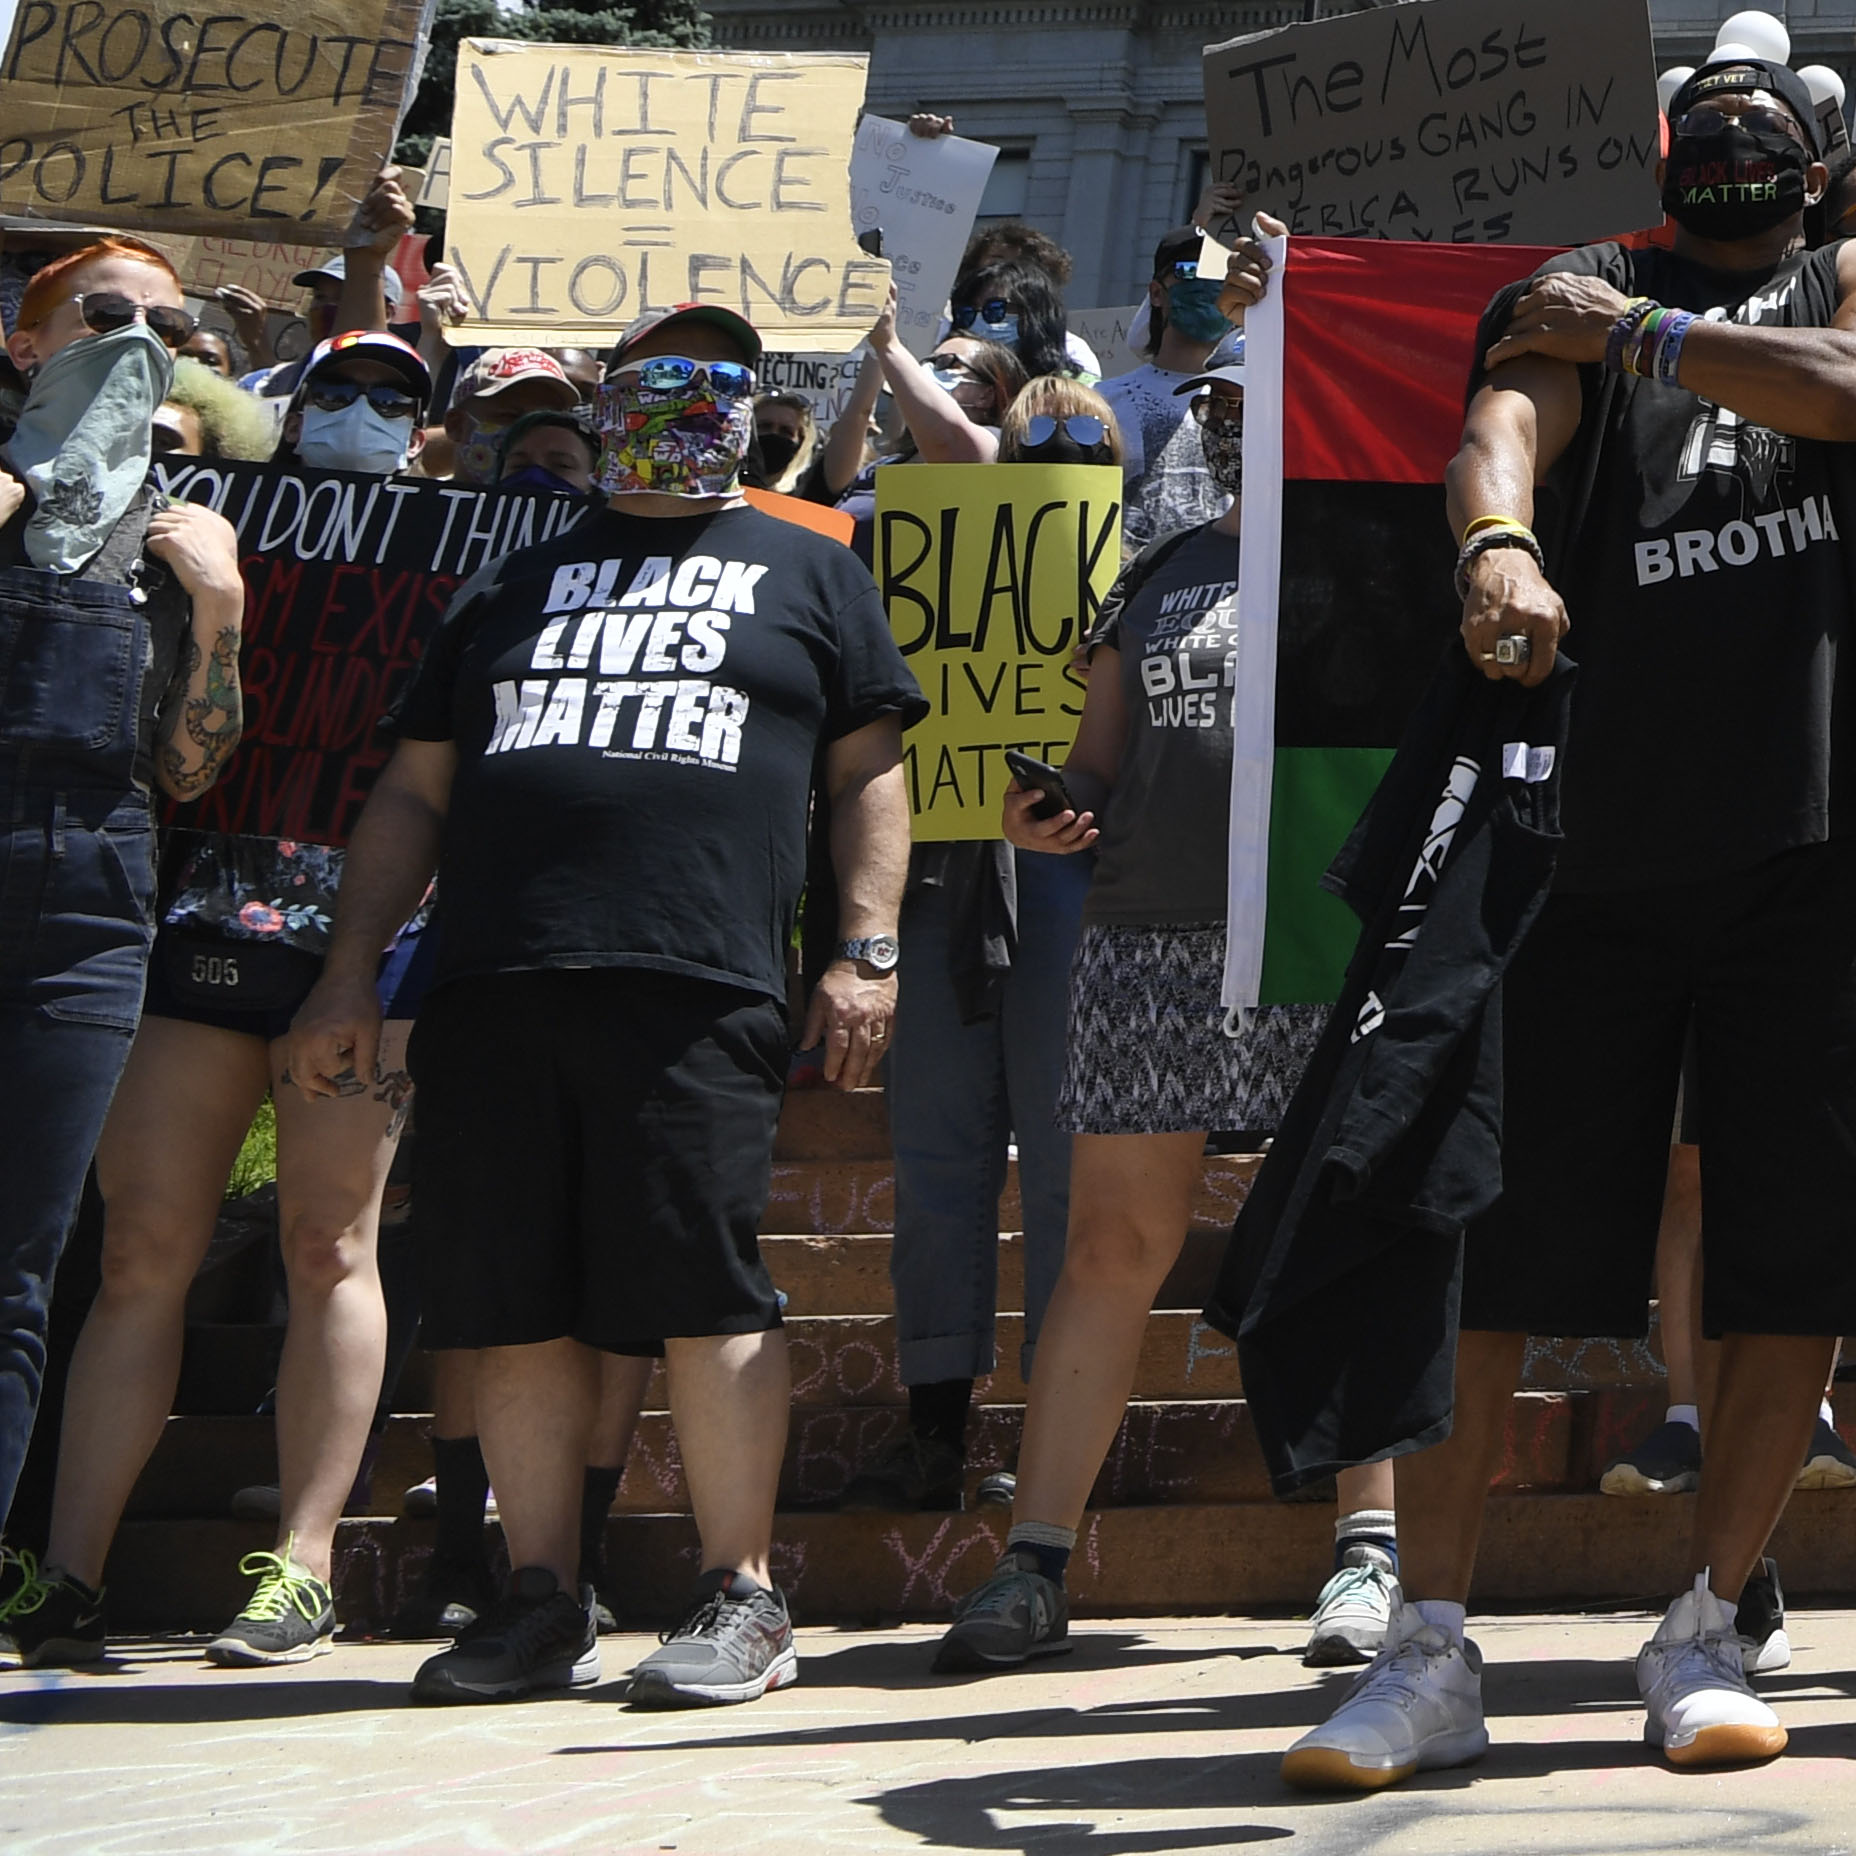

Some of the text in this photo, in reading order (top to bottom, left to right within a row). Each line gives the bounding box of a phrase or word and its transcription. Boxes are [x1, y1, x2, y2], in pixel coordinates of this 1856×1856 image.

[7, 1, 415, 106] PROSECUTE
[1229, 16, 1547, 136] The Most
[112, 101, 224, 144] THE
[473, 64, 804, 141] WHITE
[1416, 90, 1536, 156] GANG
[1565, 77, 1614, 127] IN
[462, 136, 831, 211] SILENCE
[1452, 145, 1578, 215] RUNS
[1597, 129, 1659, 170] ON
[1681, 183, 1777, 204] MATTER
[542, 555, 769, 614] BLACK
[881, 501, 1120, 656] BLACK
[530, 610, 731, 674] LIVES
[1145, 634, 1221, 654] WHITE
[484, 677, 750, 764] MATTER
[1149, 692, 1216, 728] LIVES
